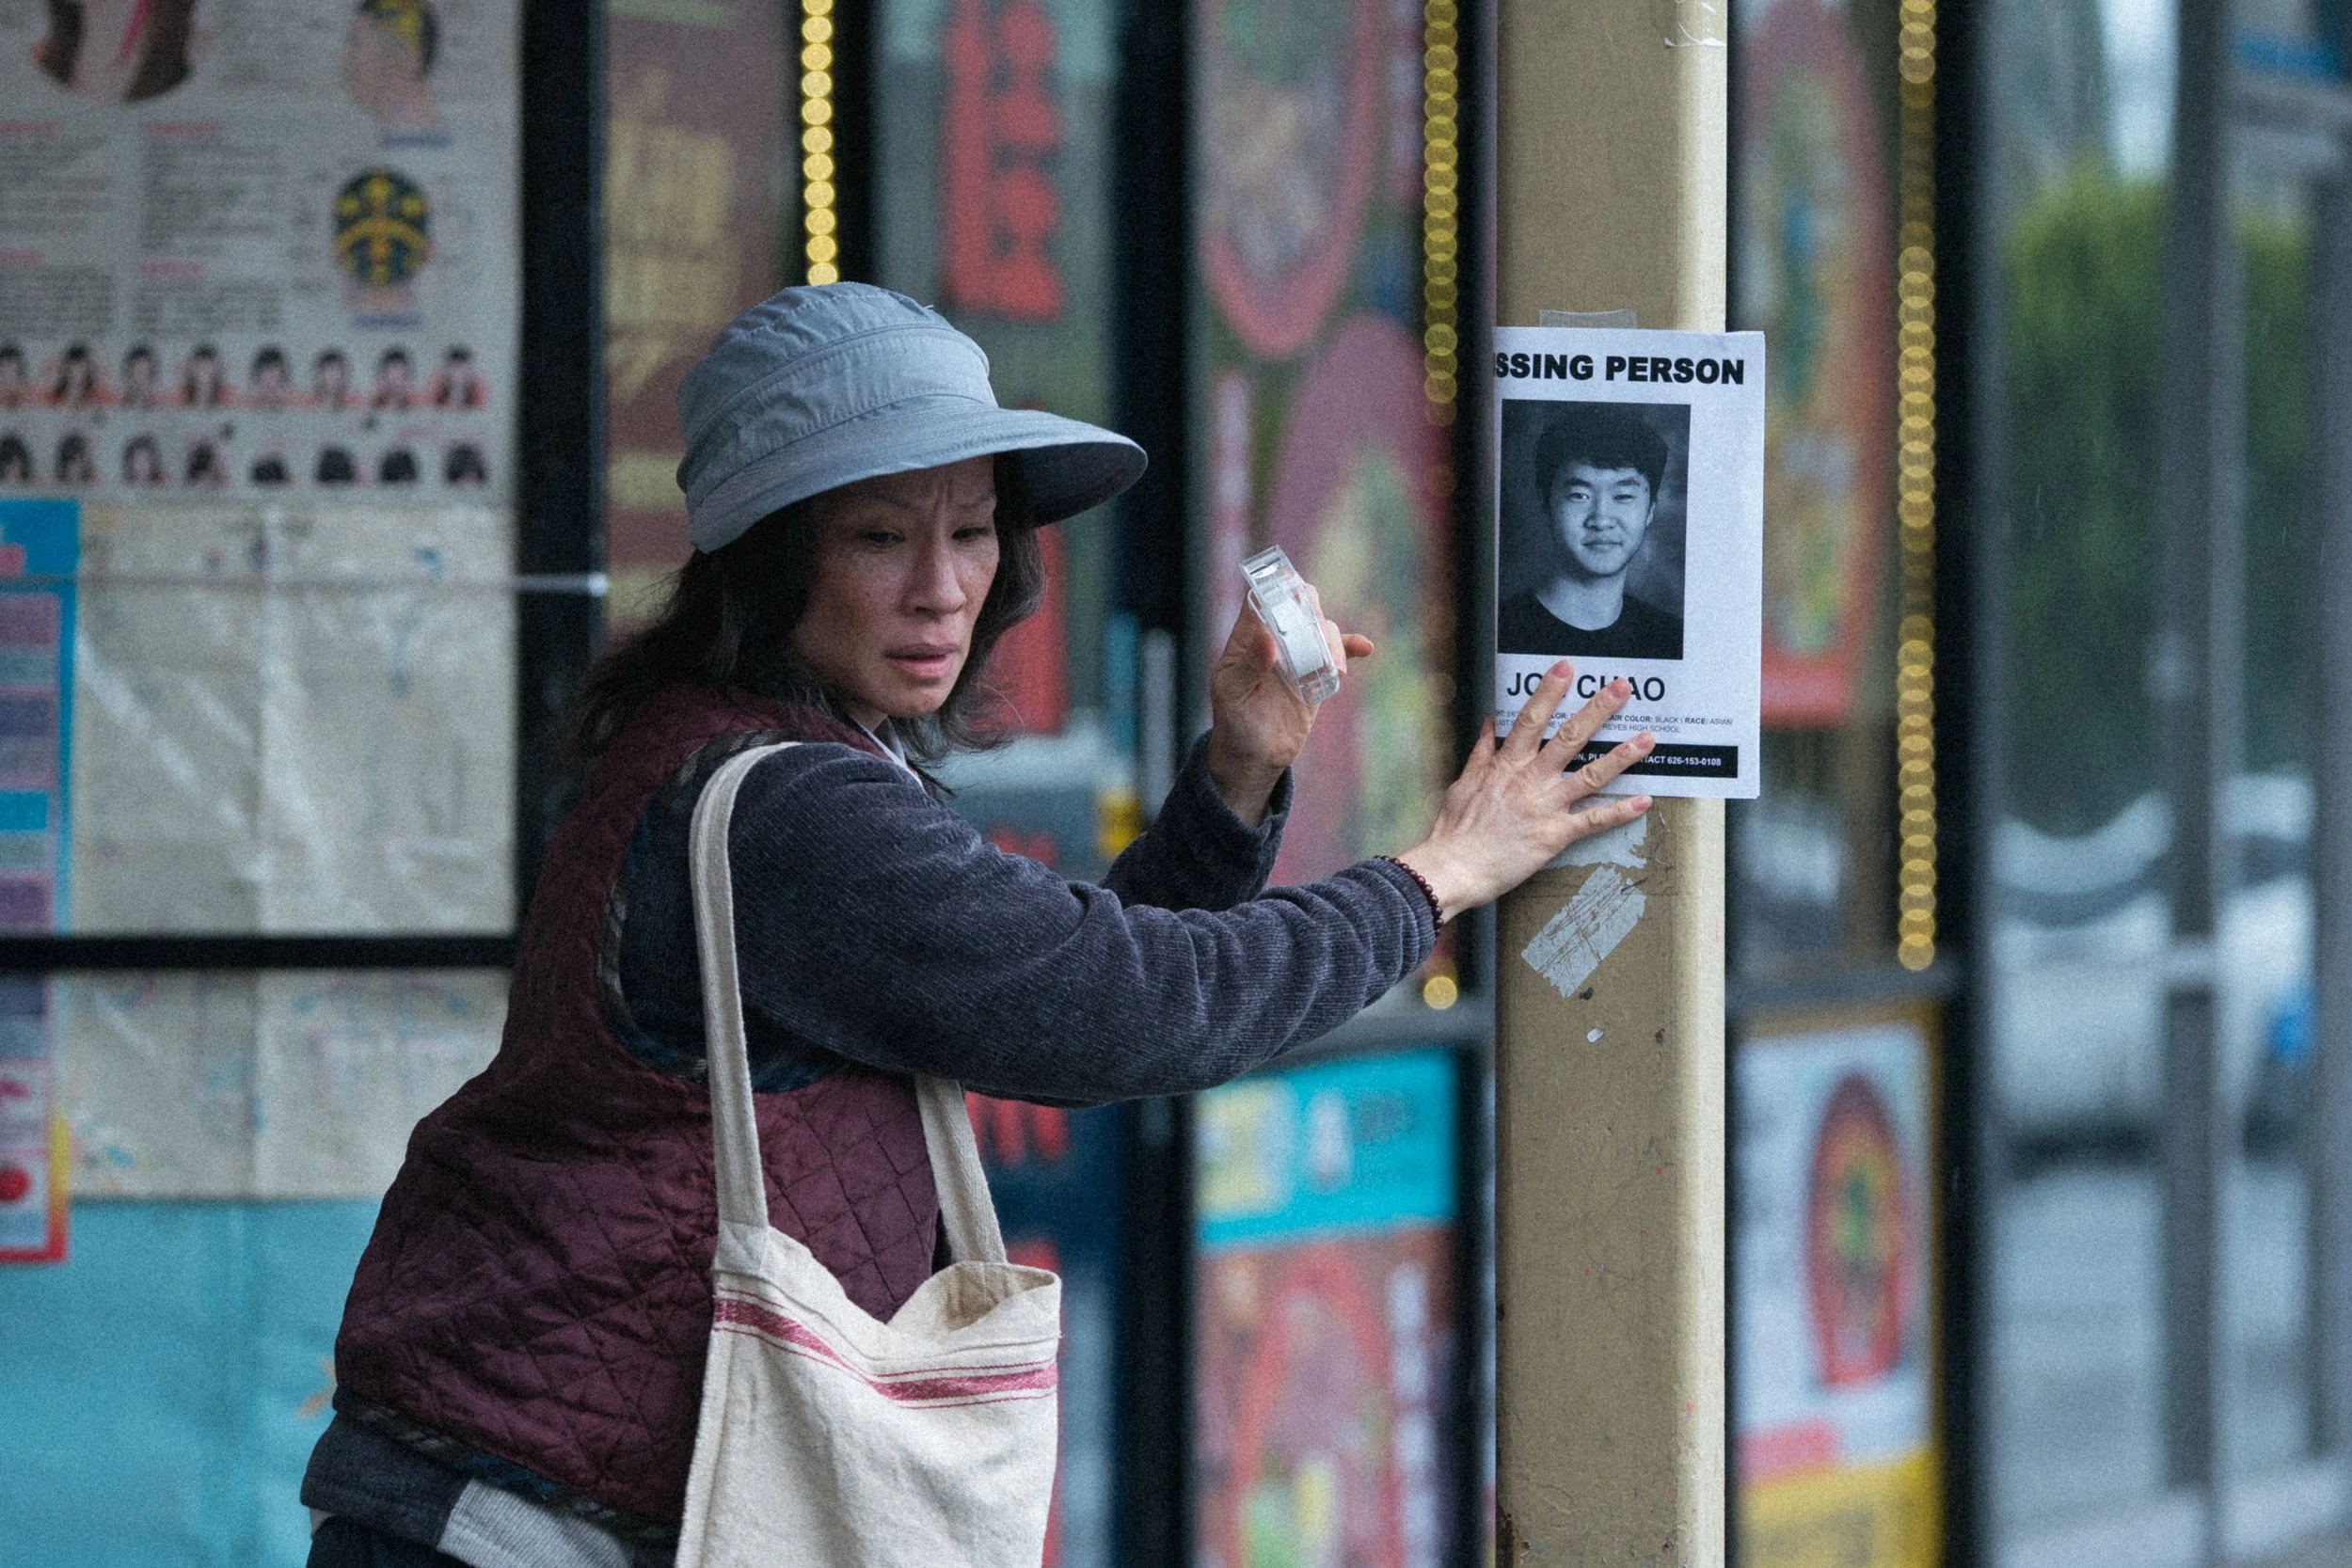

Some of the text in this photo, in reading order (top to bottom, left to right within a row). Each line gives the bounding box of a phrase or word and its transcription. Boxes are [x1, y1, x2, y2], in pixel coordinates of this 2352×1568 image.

[1605, 356, 1745, 386] PERSON
[1507, 672, 1566, 698] JO
[1602, 722, 1628, 731] REYES
[1629, 723, 1648, 732] HIGH
[1649, 724, 1680, 733] SCHOOL
[1709, 718, 1733, 726] ASIAN
[1666, 756, 1722, 767] 626-153-0108
